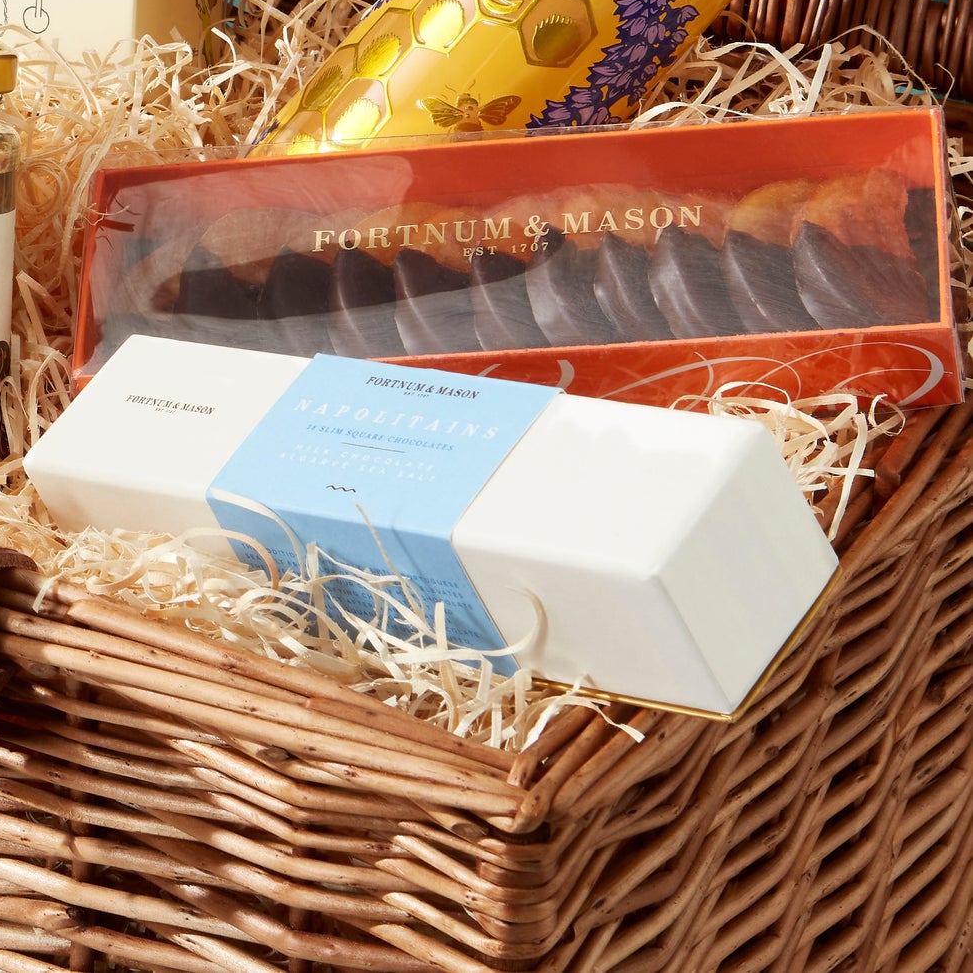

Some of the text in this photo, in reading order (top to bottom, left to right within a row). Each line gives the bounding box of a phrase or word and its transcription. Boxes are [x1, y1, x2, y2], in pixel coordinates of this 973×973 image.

[311, 205, 703, 253] FORTNUM & MASON
[463, 242, 550, 258] EST 1707
[366, 376, 480, 399] FORTNUM & MASON
[126, 394, 215, 415] FORTNUM & MASON
[293, 398, 499, 440] NAPOLITAINS
[318, 426, 344, 435] SLIM
[345, 429, 385, 442] SQUARE
[387, 435, 455, 452] CHOCOLATES
